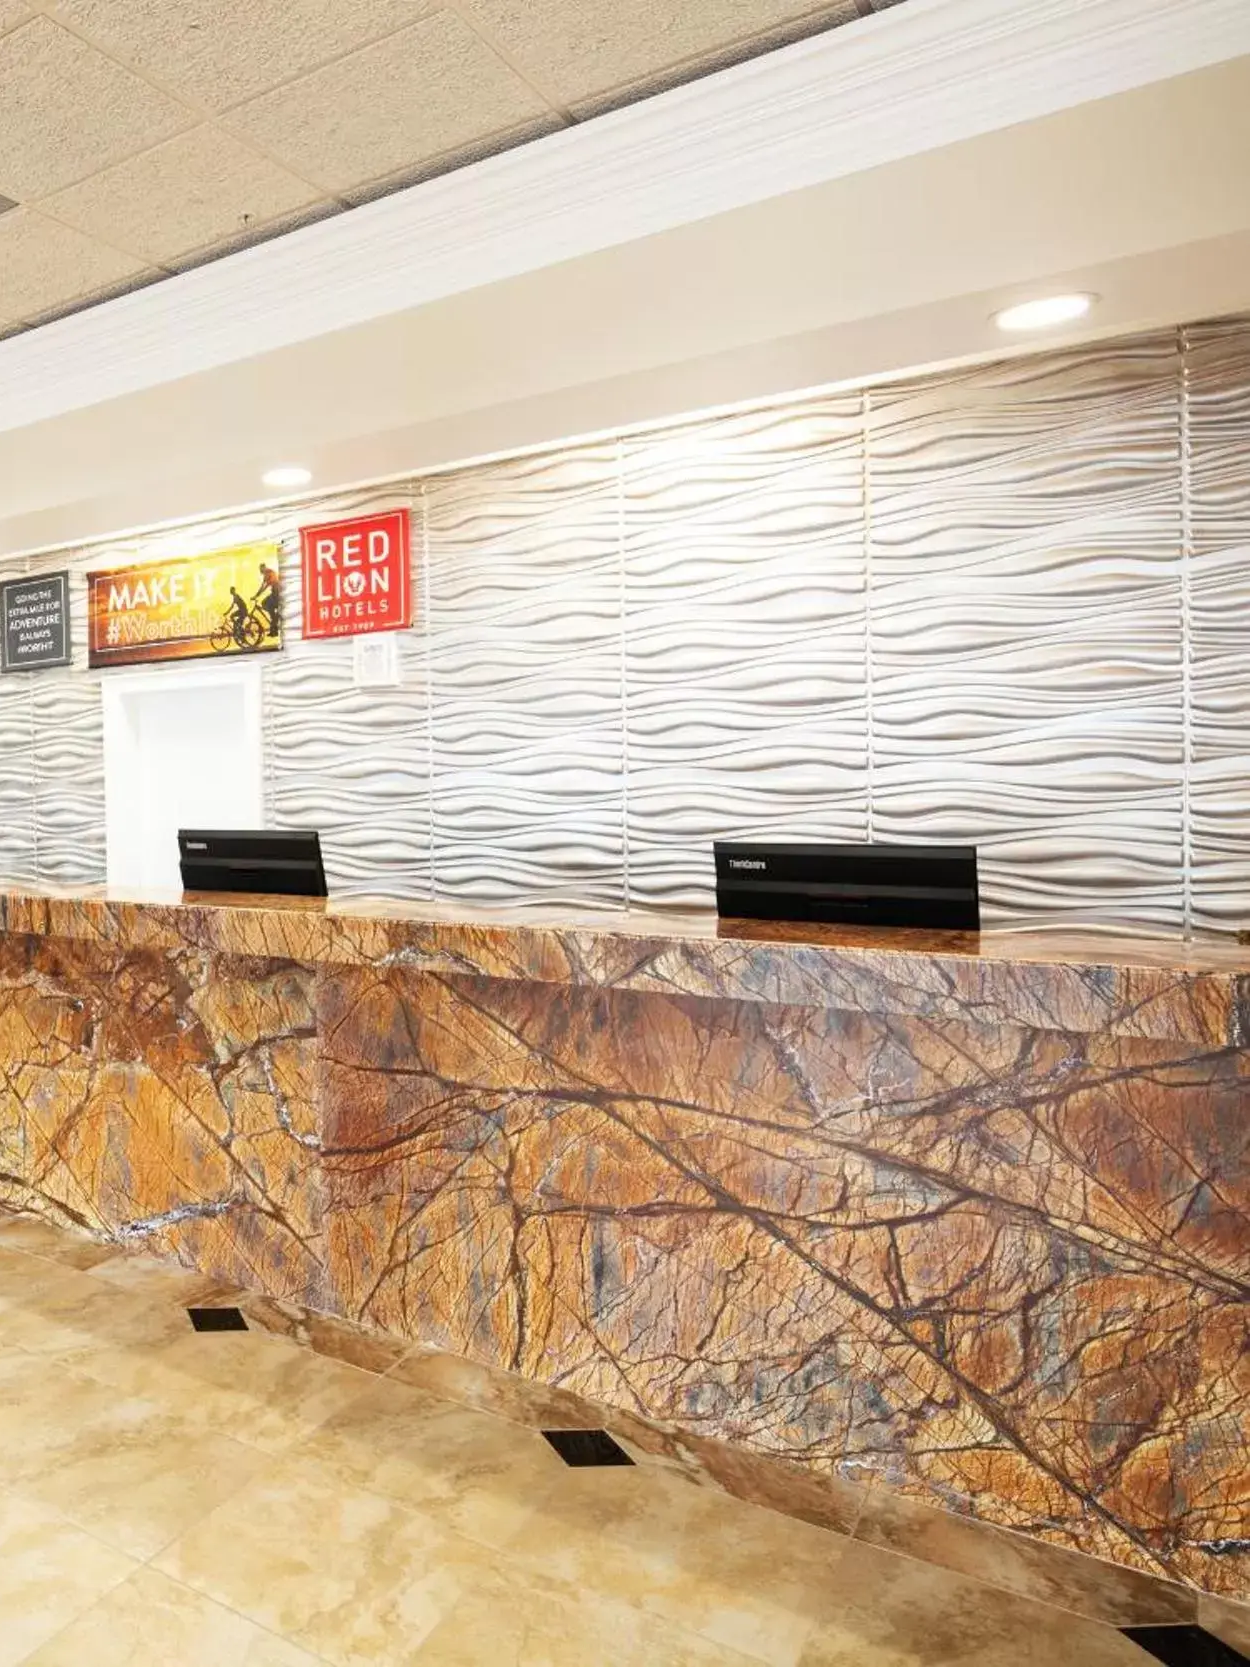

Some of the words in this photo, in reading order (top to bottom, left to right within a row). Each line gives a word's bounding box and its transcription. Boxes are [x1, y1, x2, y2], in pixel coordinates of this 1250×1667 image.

[316, 530, 390, 572] RED
[108, 574, 185, 612] MAKE
[195, 567, 217, 601] IT
[318, 566, 389, 602] LION
[10, 613, 60, 630] ADVENTURE
[319, 600, 389, 620] HOTELS
